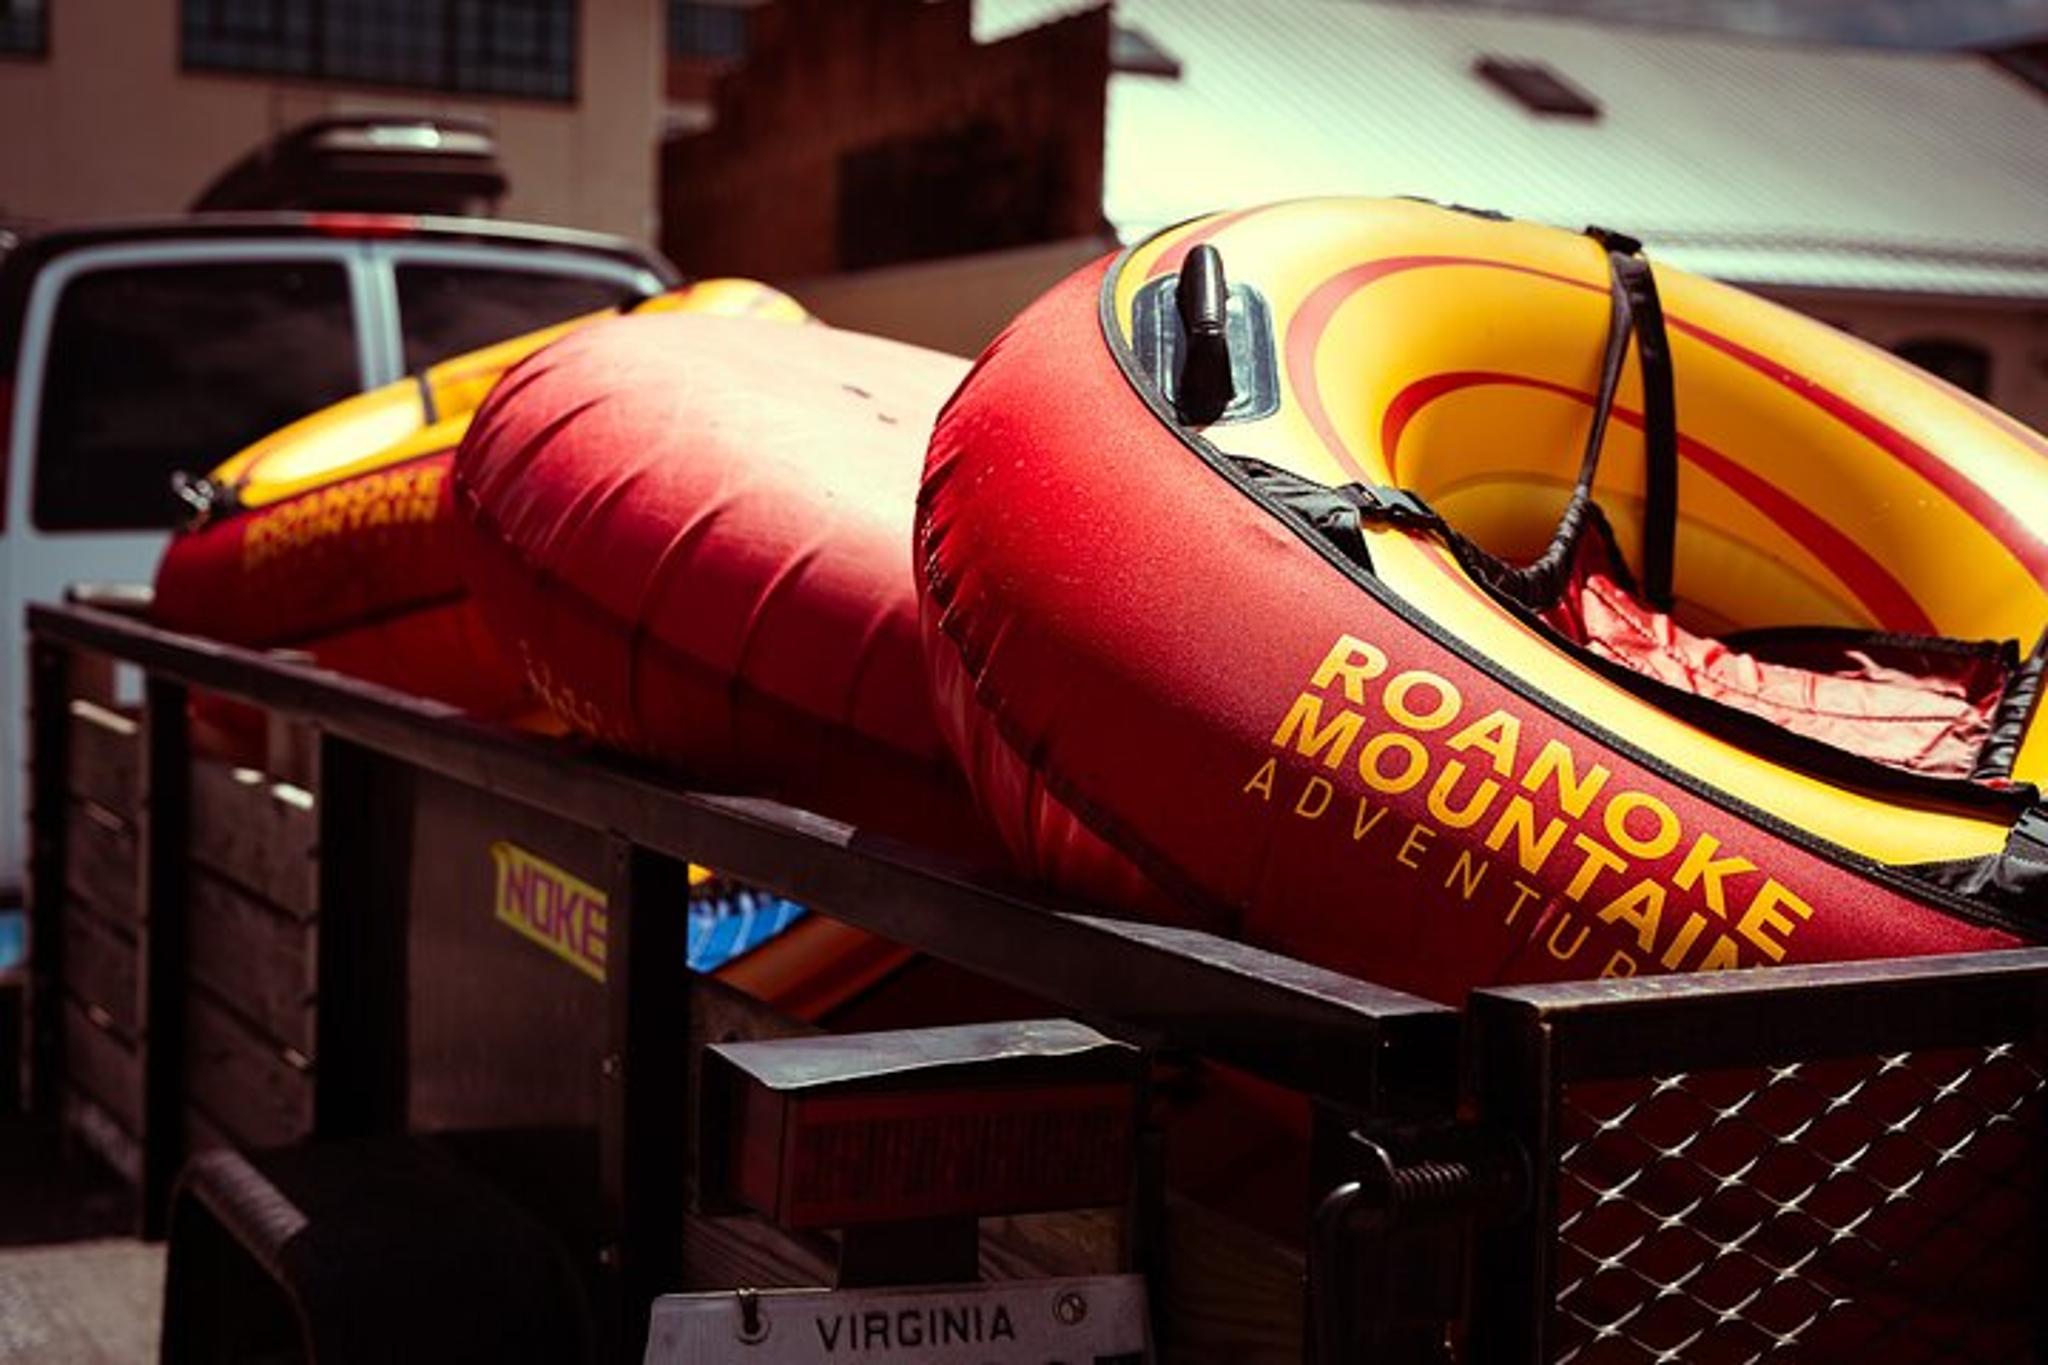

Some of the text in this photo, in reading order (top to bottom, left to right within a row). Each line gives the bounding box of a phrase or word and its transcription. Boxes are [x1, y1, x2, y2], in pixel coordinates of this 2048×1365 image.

[1310, 634, 1813, 962] ROANOKE
[505, 861, 608, 967] NOKE
[816, 1307, 1016, 1352] VIRGINIA
